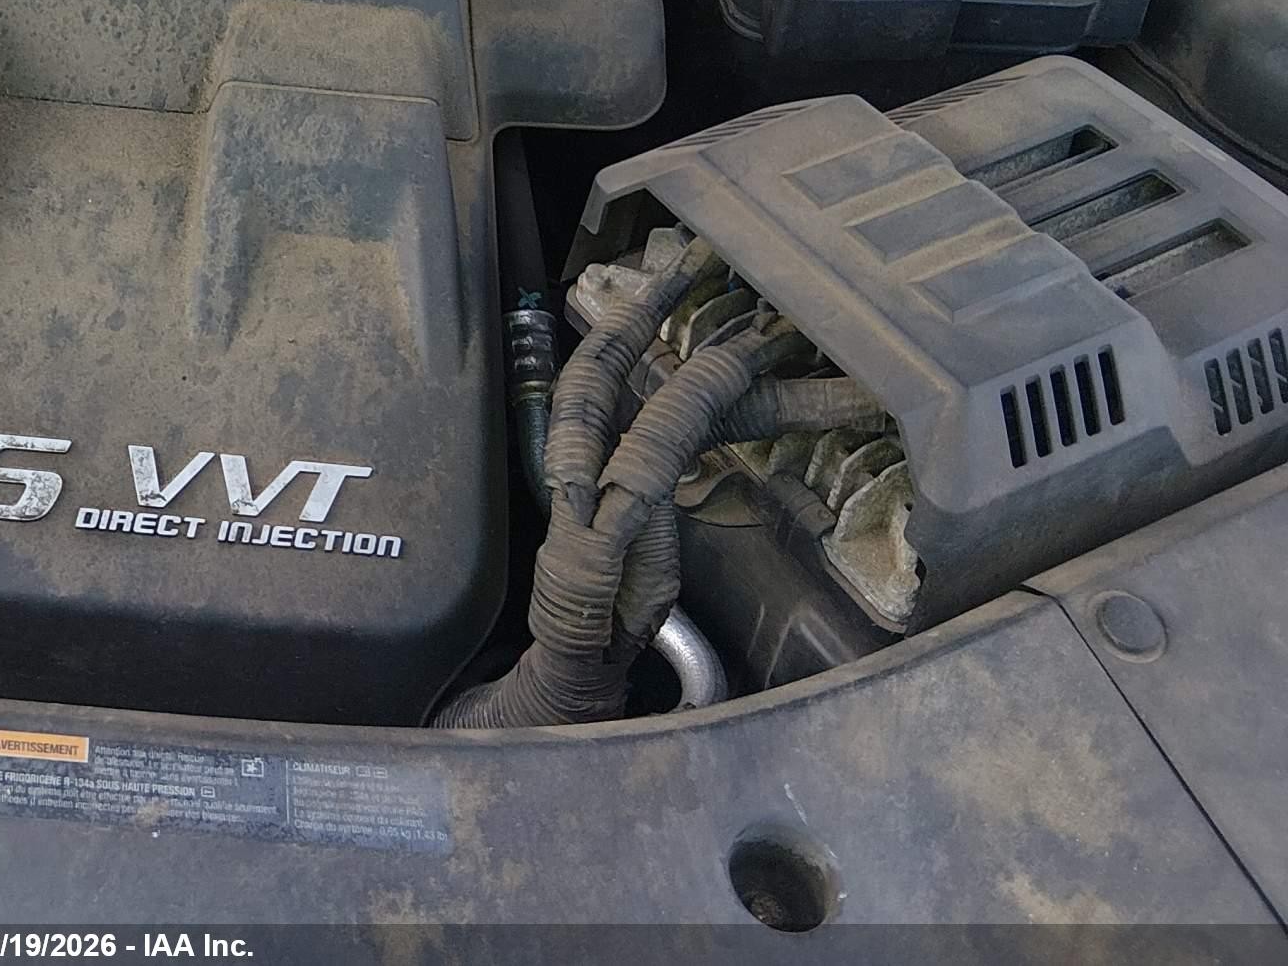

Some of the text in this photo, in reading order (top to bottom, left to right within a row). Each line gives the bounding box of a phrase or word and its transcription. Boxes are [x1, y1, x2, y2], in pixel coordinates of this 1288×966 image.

[127, 444, 374, 523] VVT
[74, 506, 404, 558] DIRECT INJECTION
[63, 775, 94, 788] R-134a
[96, 780, 120, 791] SOUS
[122, 782, 150, 794] HAUTE
[152, 784, 196, 797] PRESSION
[293, 762, 351, 775] CLIMATISEUR
